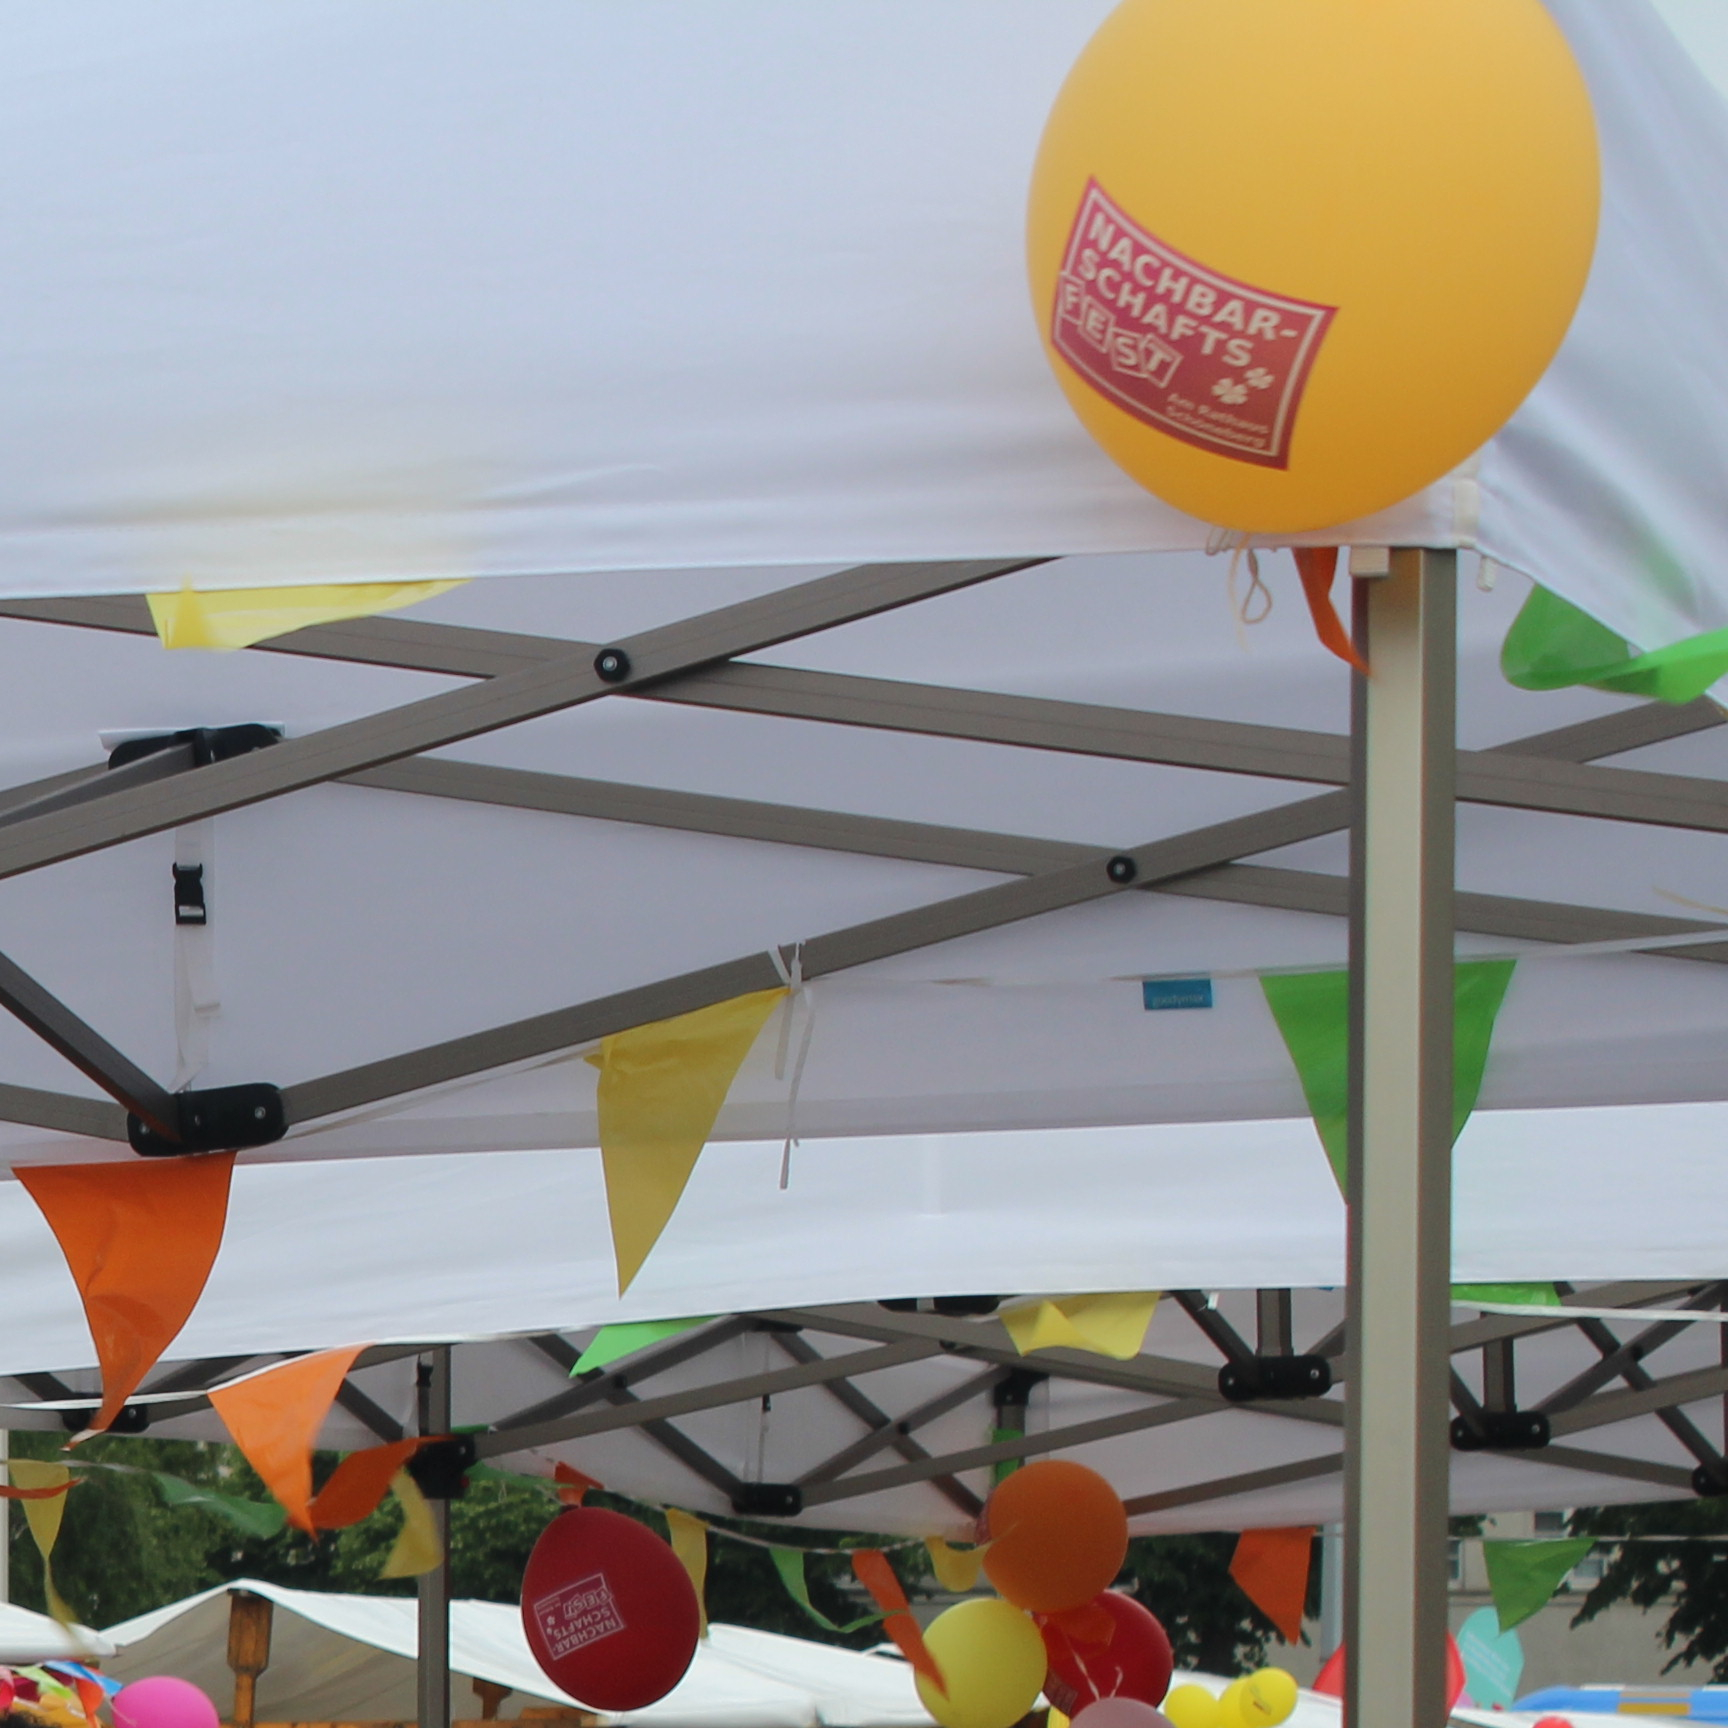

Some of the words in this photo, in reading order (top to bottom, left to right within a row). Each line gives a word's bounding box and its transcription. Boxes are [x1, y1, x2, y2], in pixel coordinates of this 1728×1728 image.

[1062, 280, 1174, 374] FEST
[1077, 248, 1255, 367] SCHAFTS
[1088, 211, 1298, 341] NACHBAR-
[553, 1606, 611, 1641] SCHAFTS
